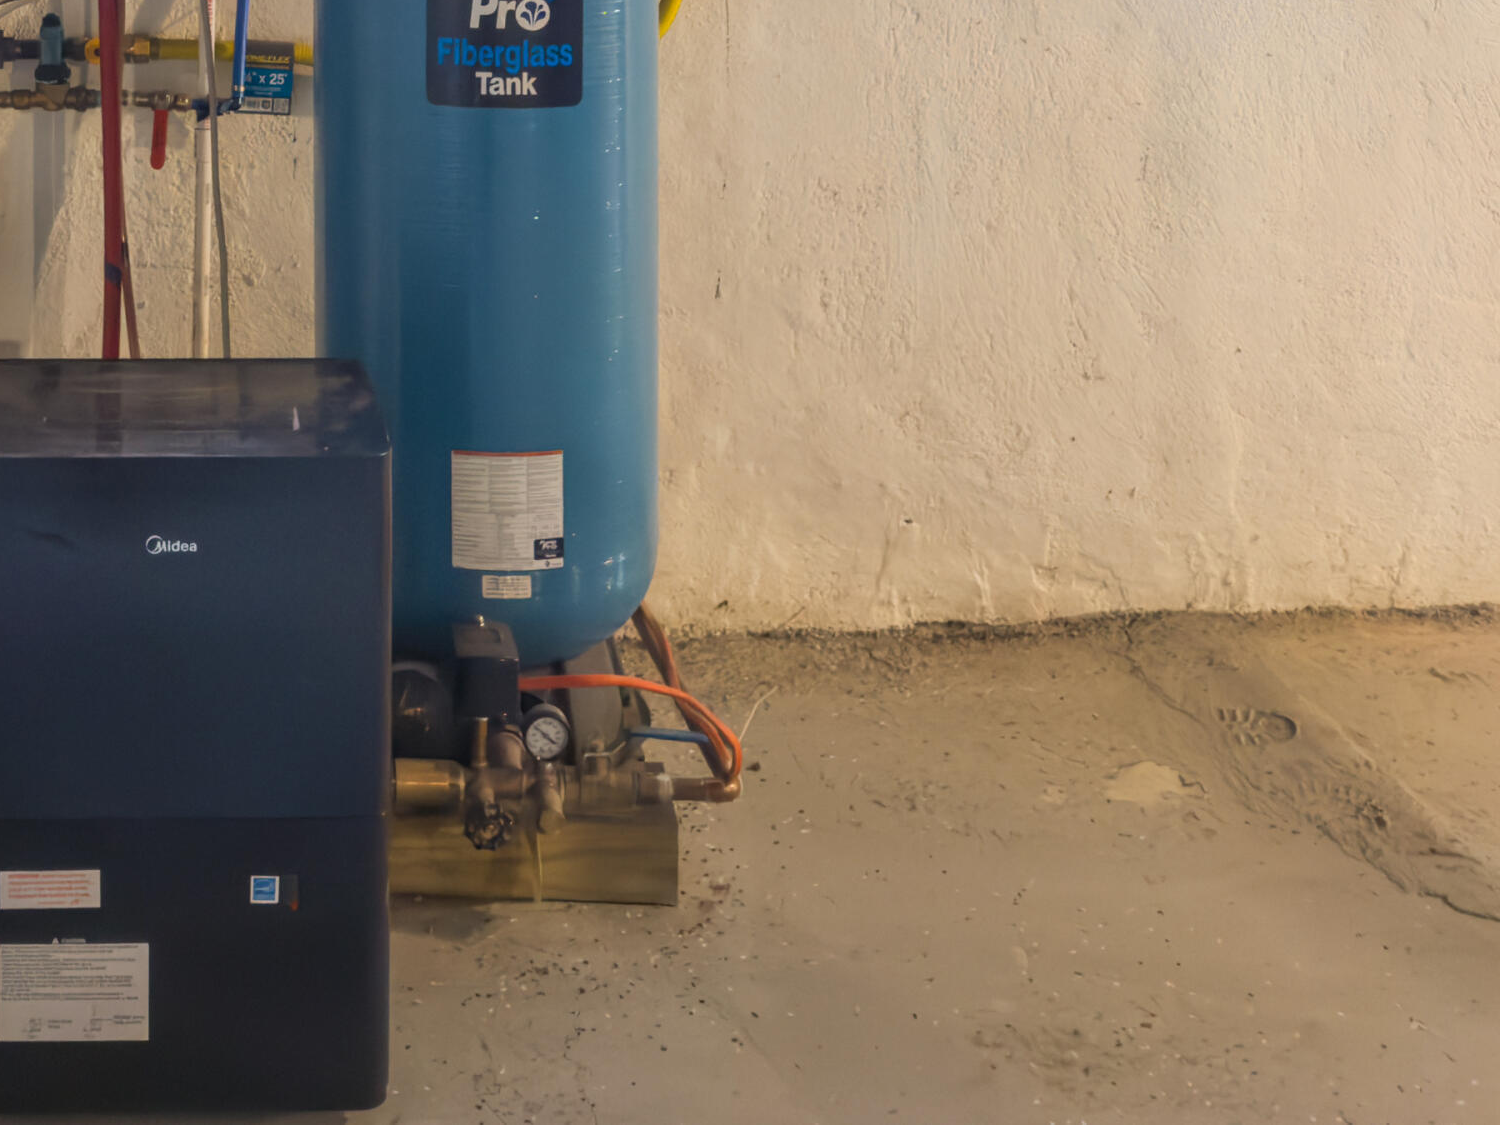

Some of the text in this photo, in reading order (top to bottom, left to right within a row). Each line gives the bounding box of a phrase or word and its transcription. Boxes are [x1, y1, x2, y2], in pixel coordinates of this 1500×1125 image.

[437, 37, 574, 75] Fiberglass
[475, 72, 538, 96] Tank
[145, 534, 198, 555] Midea
